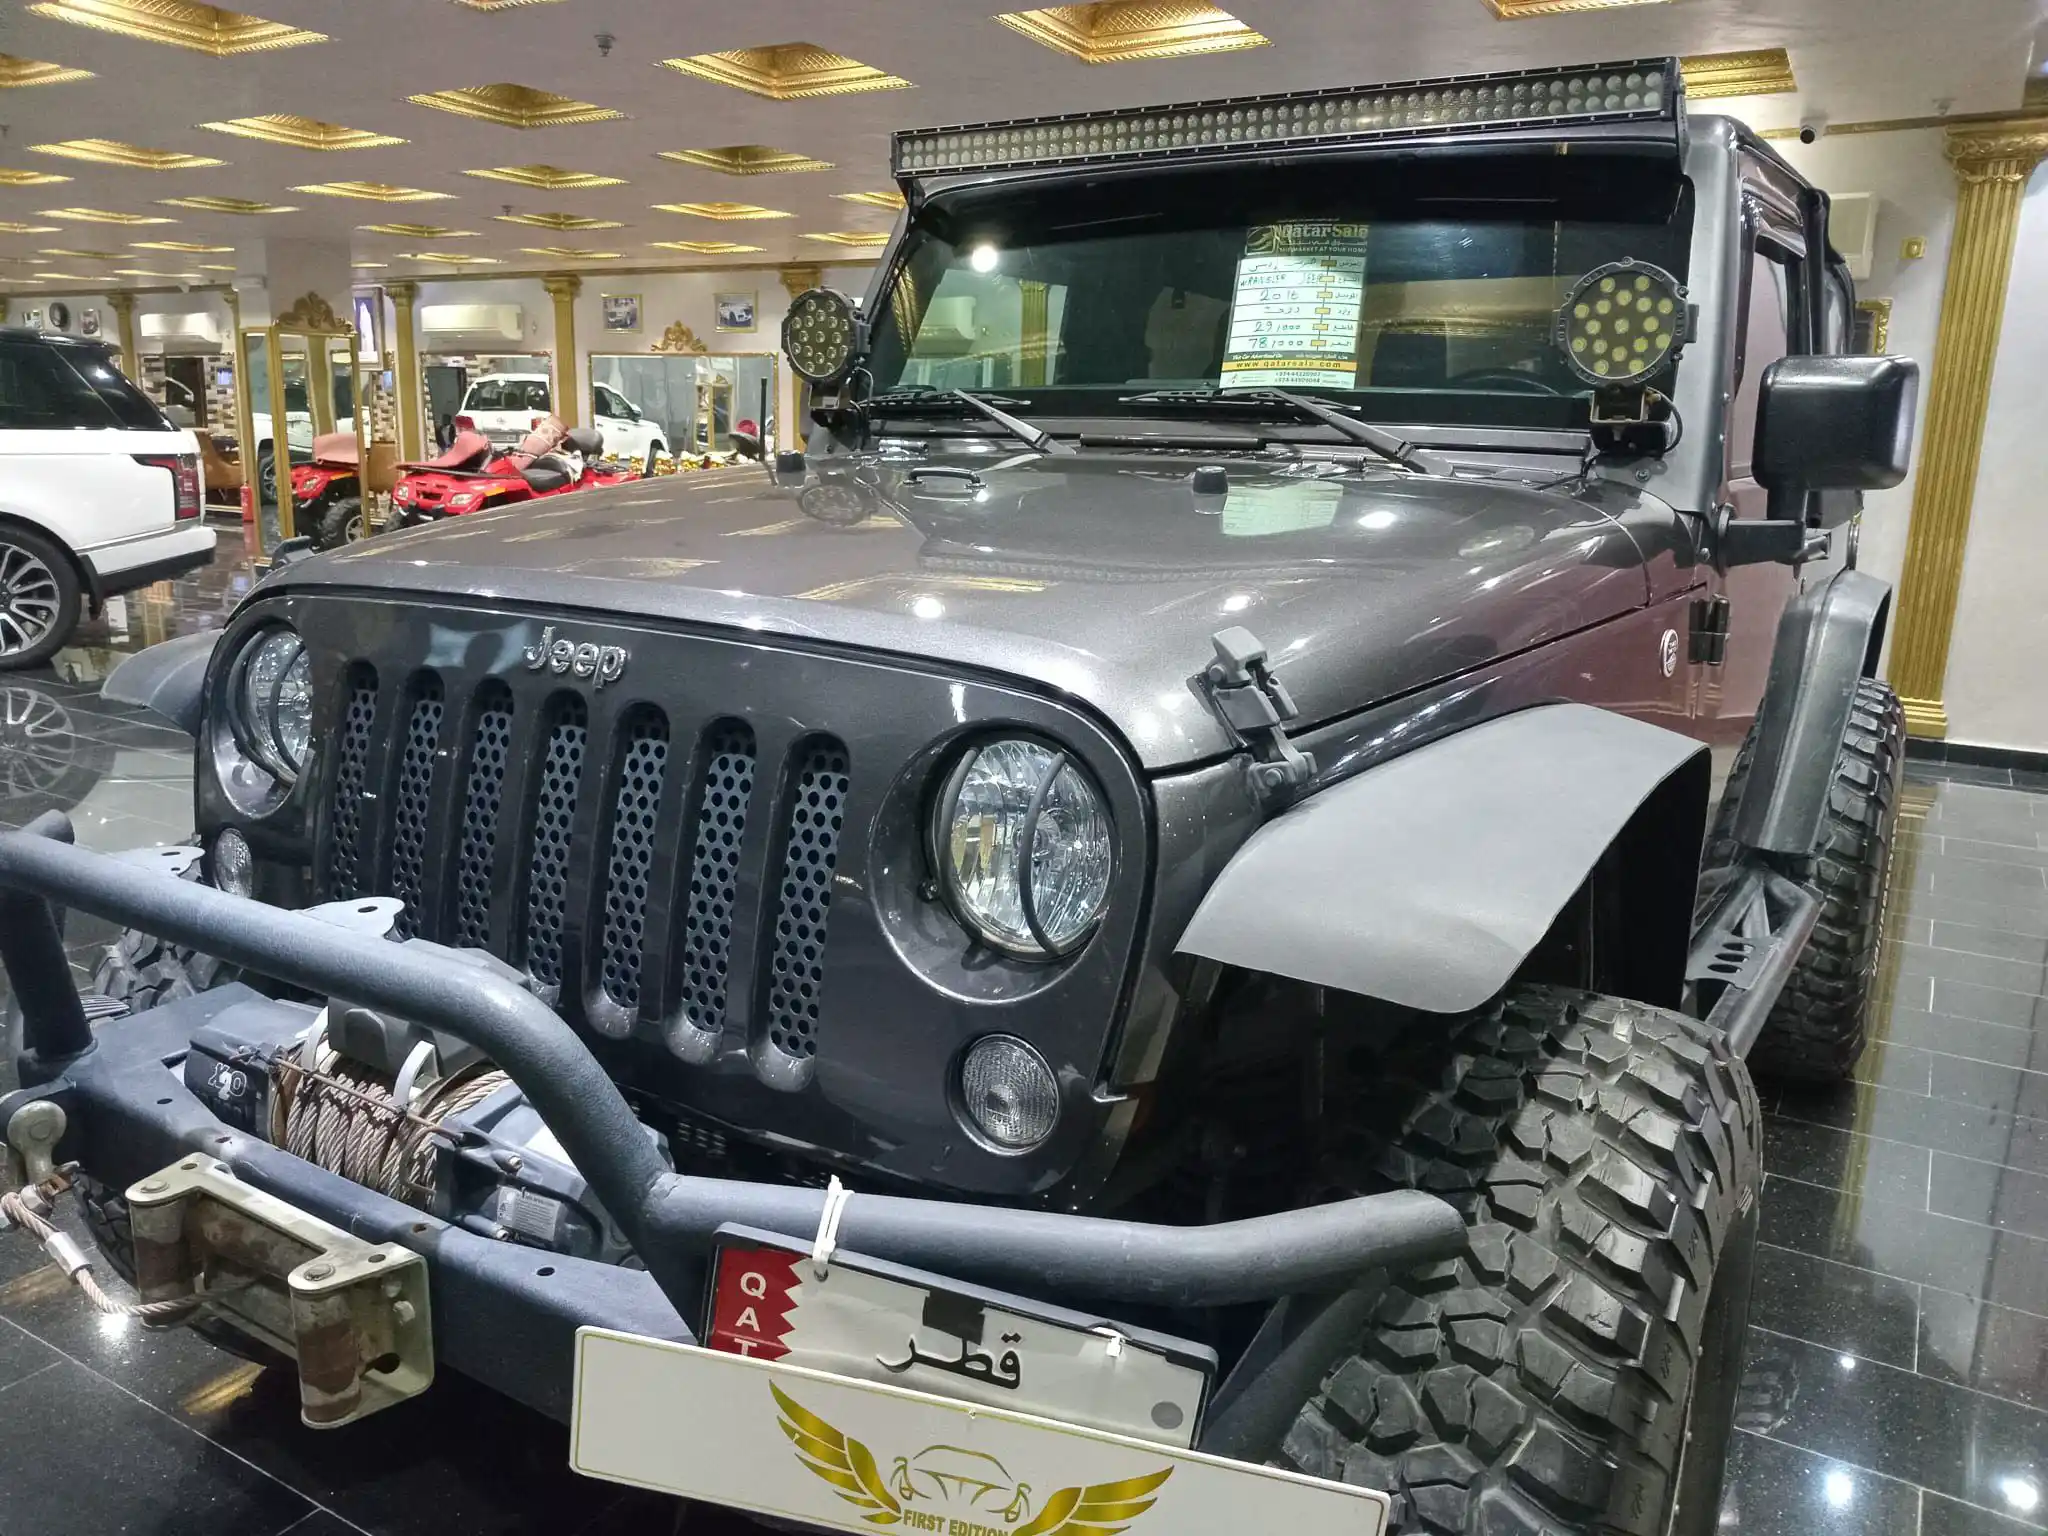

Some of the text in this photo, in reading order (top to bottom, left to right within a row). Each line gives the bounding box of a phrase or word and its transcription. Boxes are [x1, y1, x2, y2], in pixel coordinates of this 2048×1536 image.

[523, 626, 626, 689] Jeep
[876, 1332, 1022, 1390] قطر
[903, 1508, 946, 1533] FIRST
